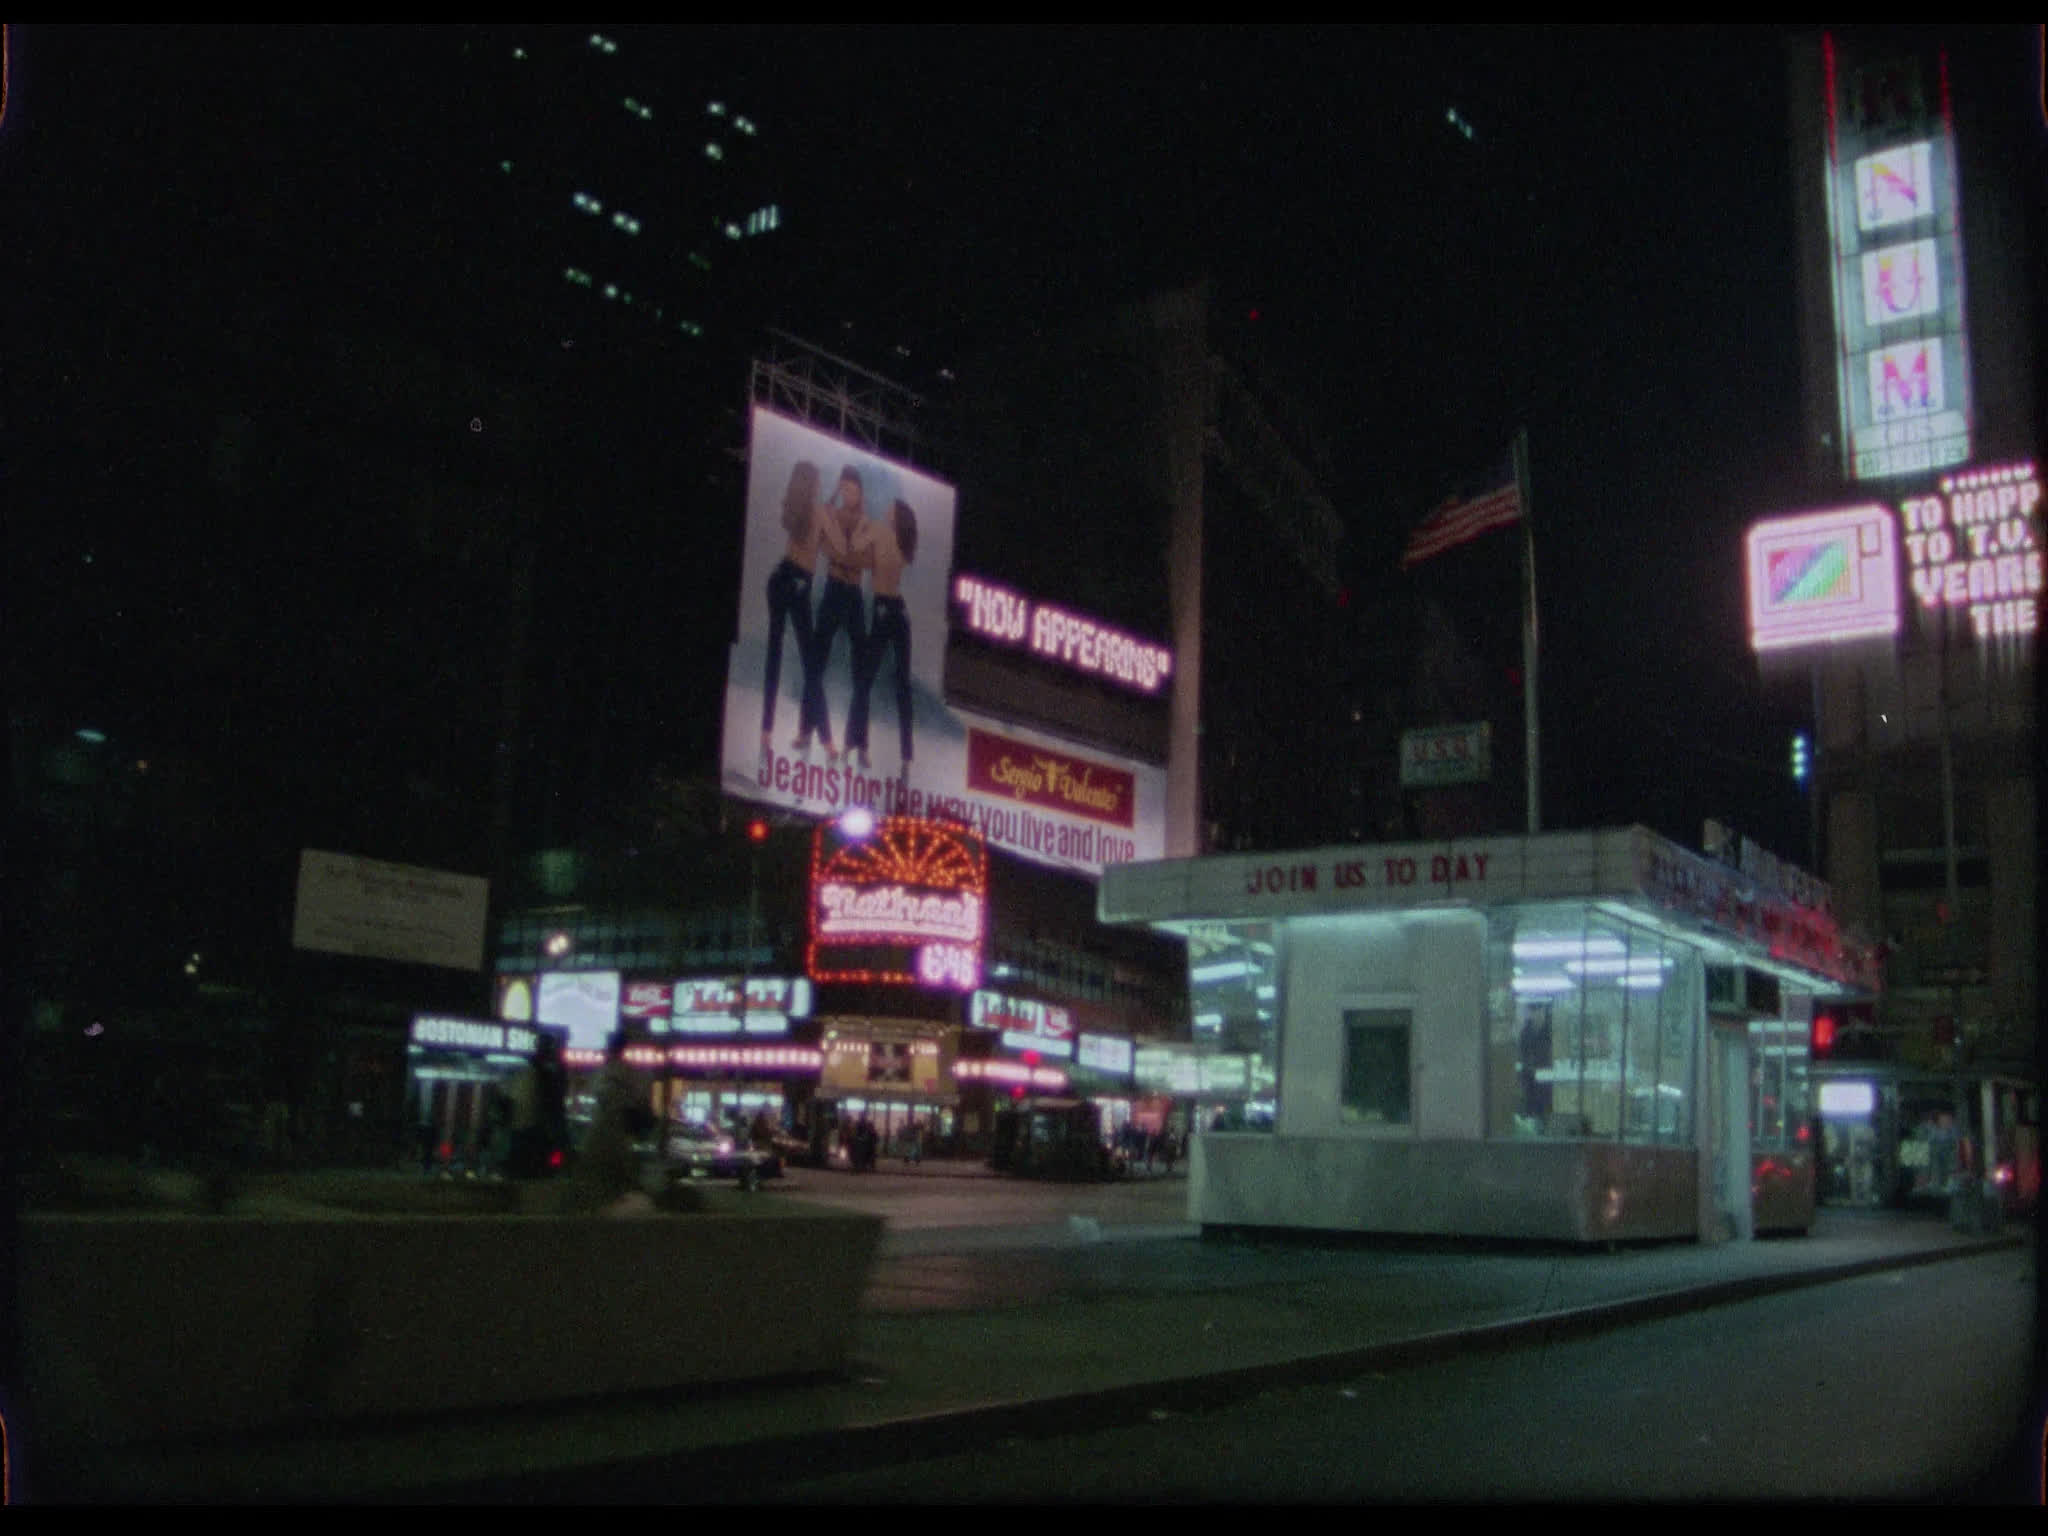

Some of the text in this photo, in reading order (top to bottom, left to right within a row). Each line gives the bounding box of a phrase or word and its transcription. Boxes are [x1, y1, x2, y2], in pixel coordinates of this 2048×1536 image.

[1902, 497, 1943, 531] TO
[1906, 531, 1952, 565] TO
[1970, 600, 2035, 637] THE
[758, 747, 841, 806] Jeans
[842, 765, 881, 808] for
[884, 774, 923, 818] the
[976, 804, 1018, 843] you
[1021, 809, 1054, 855] live
[1058, 824, 1093, 862] and
[1097, 828, 1135, 865] love
[1248, 852, 1490, 895] JOIN US TO DAY
